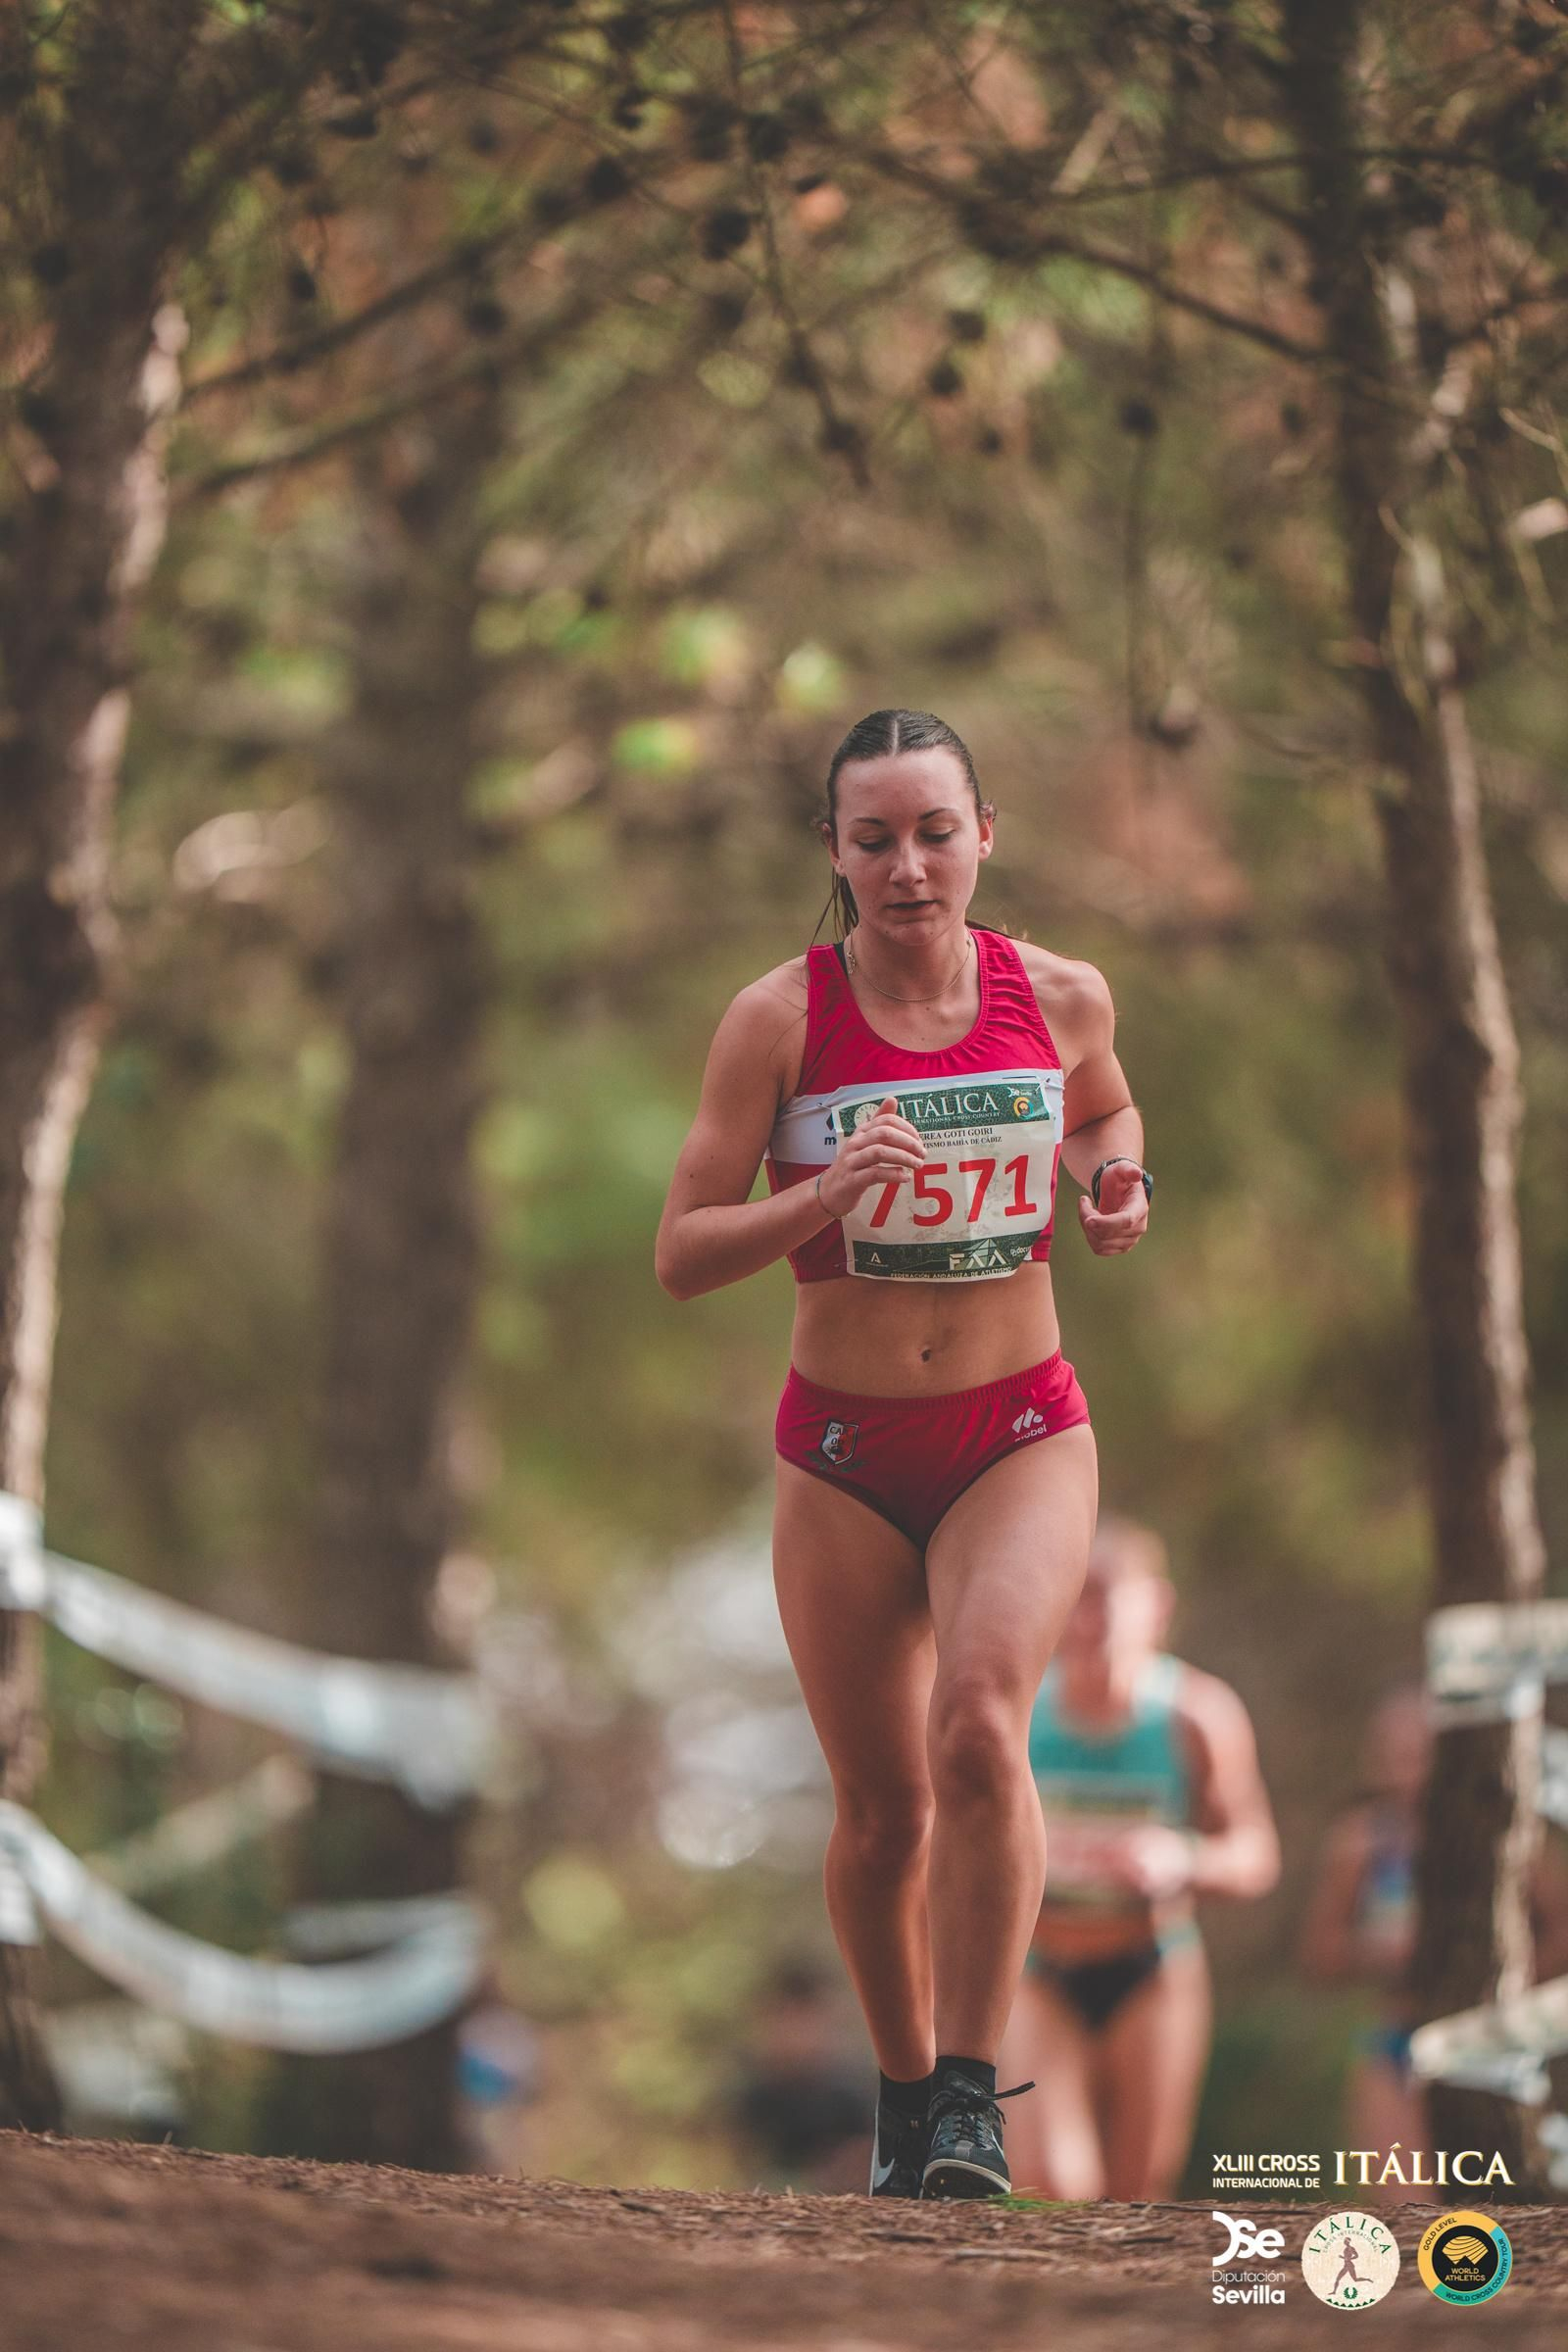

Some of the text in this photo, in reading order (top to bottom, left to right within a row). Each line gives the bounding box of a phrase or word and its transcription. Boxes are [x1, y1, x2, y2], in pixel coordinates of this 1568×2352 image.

[898, 1092, 1000, 1120] ITÁLICA
[919, 1127, 993, 1142] EREA GOTI GOIRI
[922, 1141, 946, 1150] TISMO
[981, 1136, 1003, 1145] CÁDIZ
[869, 1154, 1037, 1228] 7571
[1014, 1423, 1048, 1443] obel
